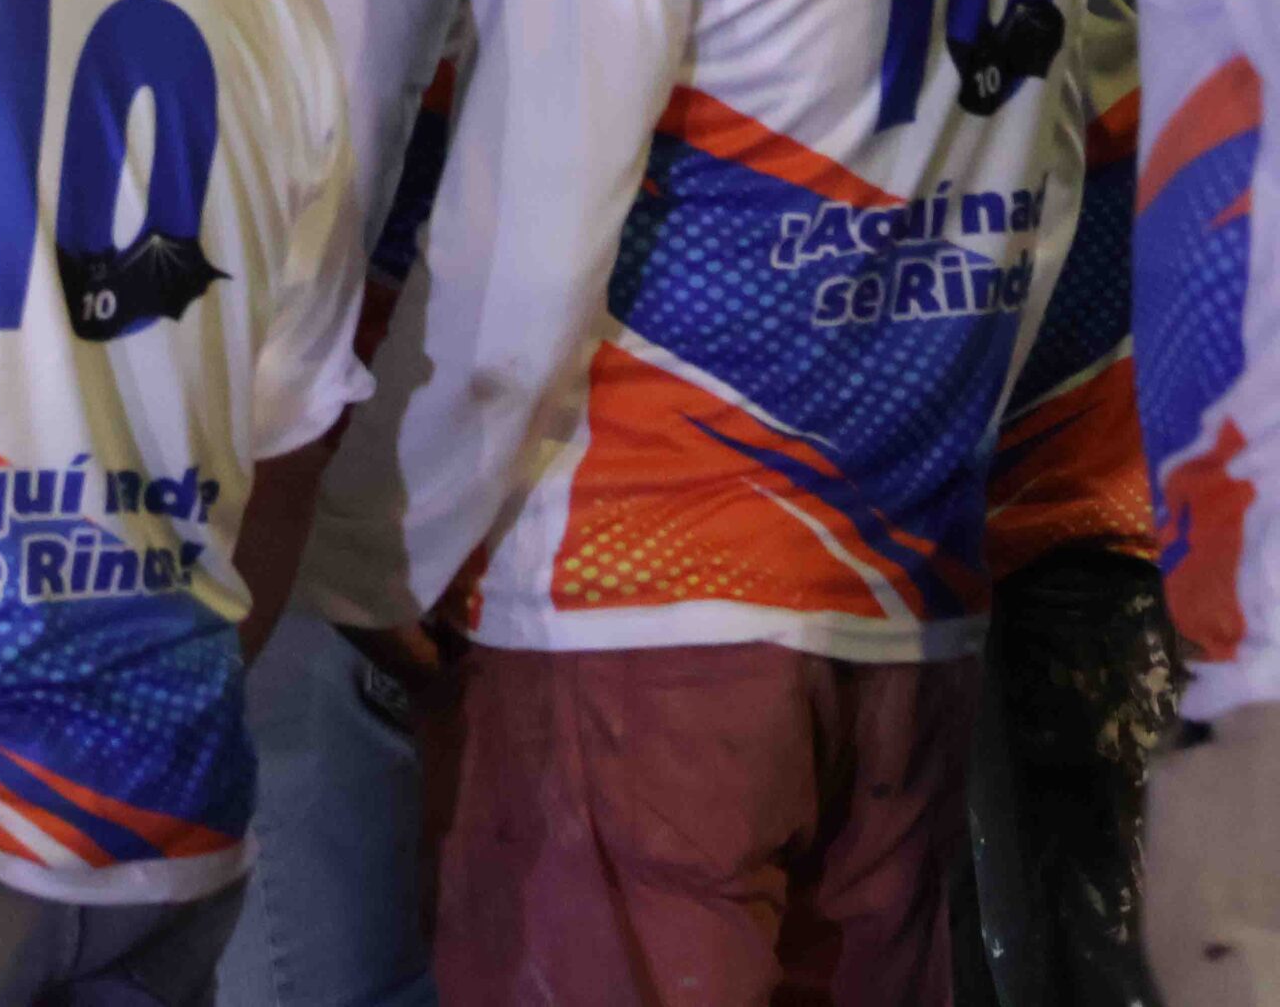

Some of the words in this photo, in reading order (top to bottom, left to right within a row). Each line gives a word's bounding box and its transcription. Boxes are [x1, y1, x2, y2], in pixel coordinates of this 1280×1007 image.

[974, 65, 1001, 98] 10
[81, 288, 117, 321] 10
[811, 273, 885, 327] se
